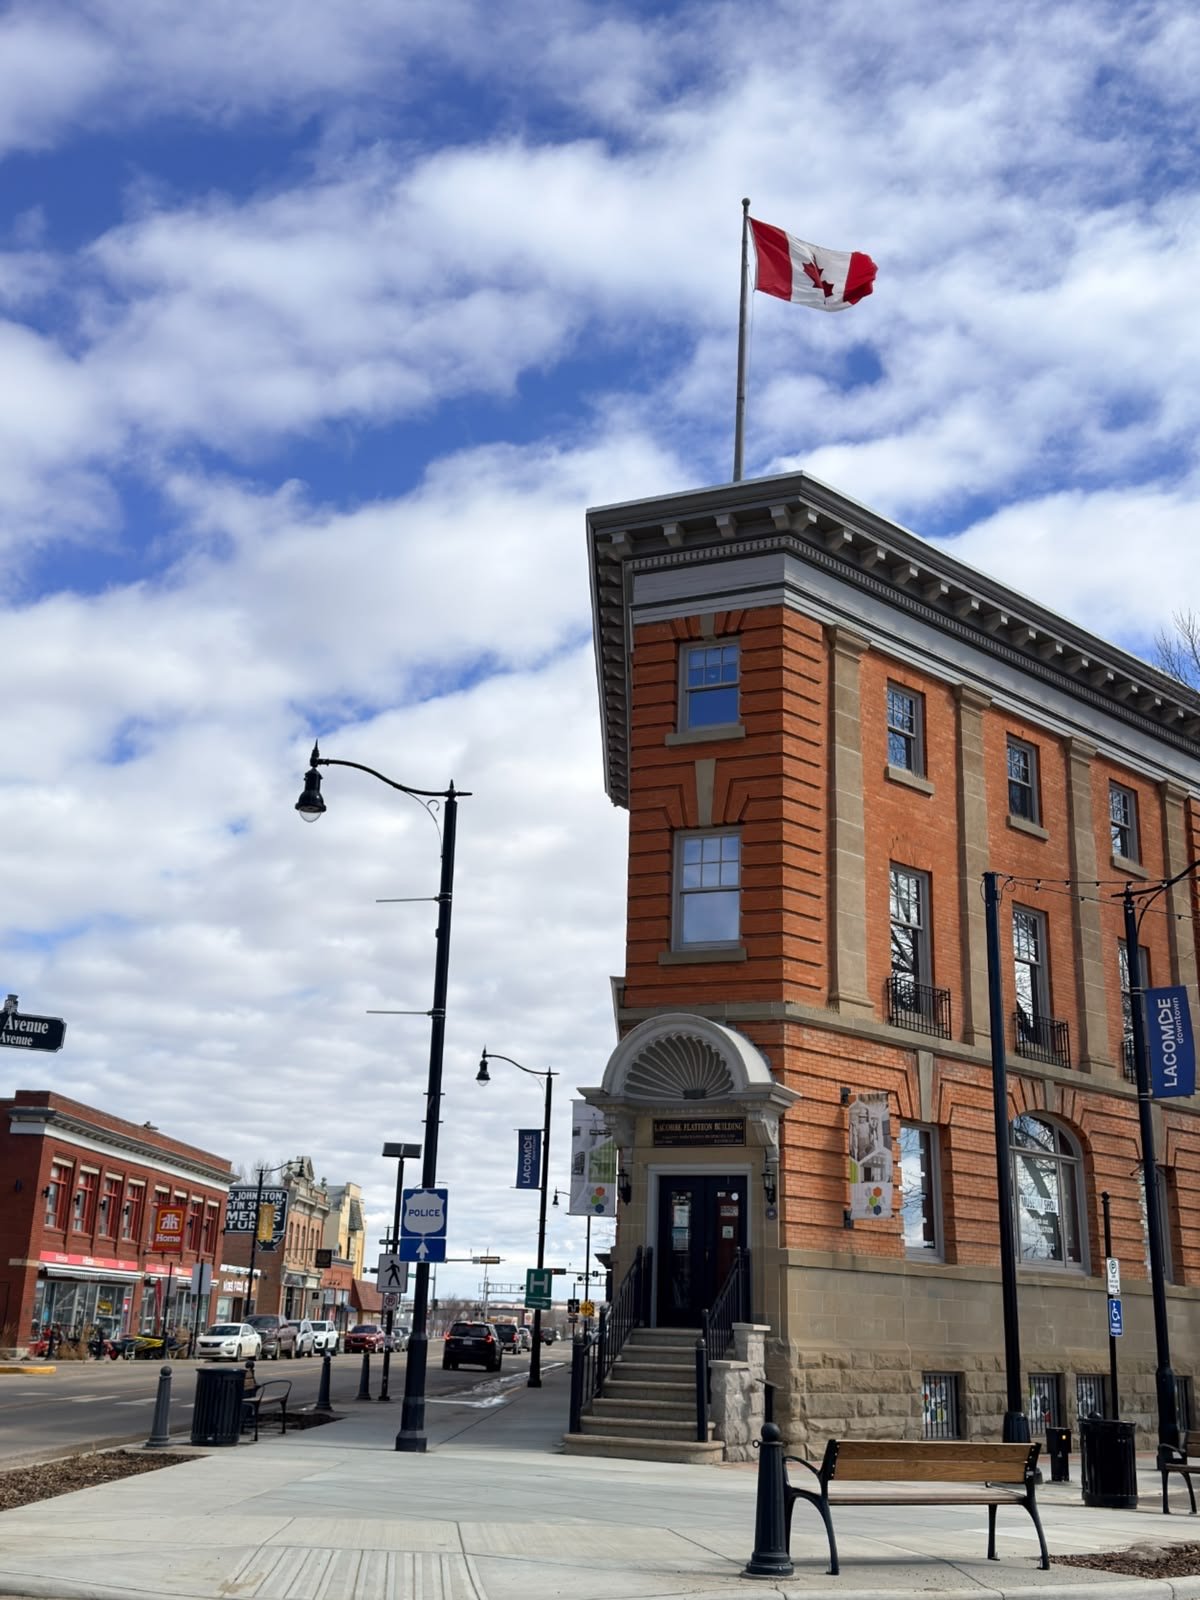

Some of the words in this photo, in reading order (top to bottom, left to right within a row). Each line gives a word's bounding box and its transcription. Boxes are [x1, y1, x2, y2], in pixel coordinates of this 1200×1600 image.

[3, 1015, 49, 1034] Avenue
[1172, 997, 1184, 1044] downtown
[0, 1031, 33, 1046] Avenue
[714, 1121, 743, 1131] BUILDING
[232, 1201, 245, 1210] TIN
[408, 1208, 440, 1217] POLICE
[156, 1233, 181, 1243] Home
[530, 1272, 549, 1294] H
